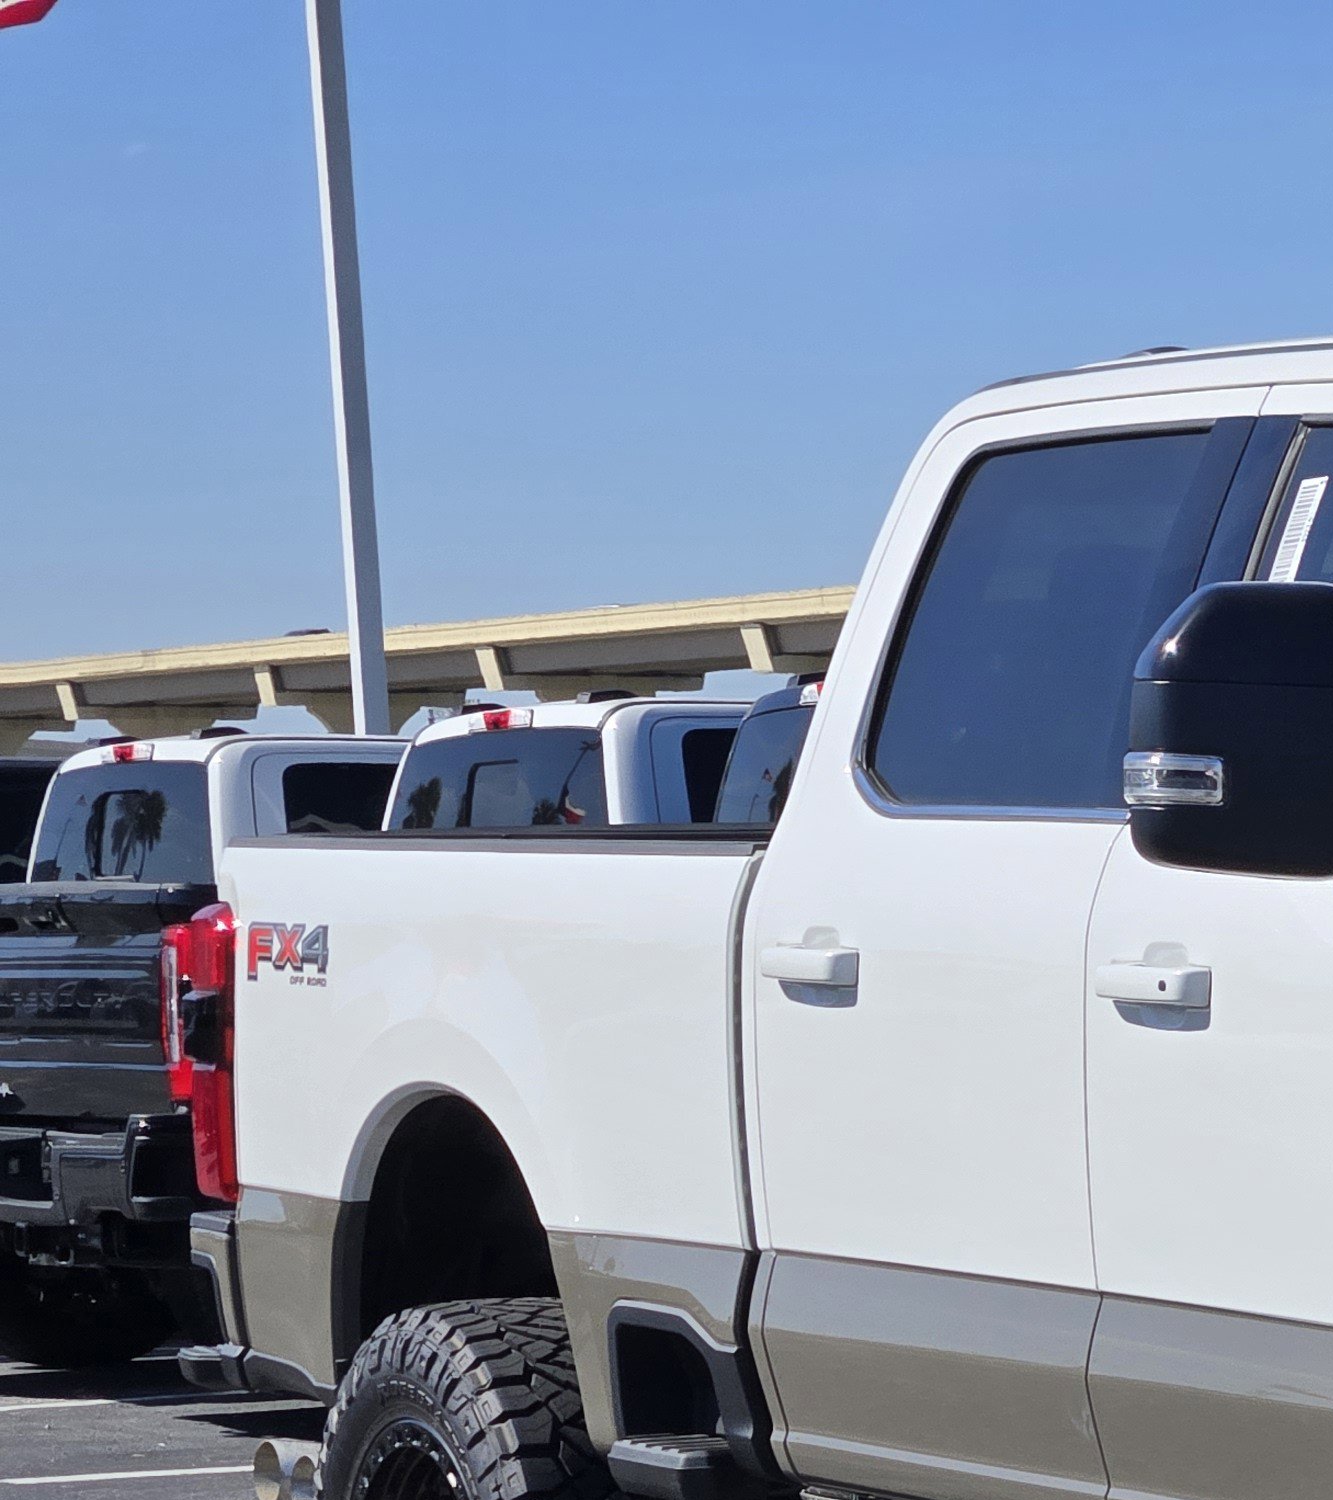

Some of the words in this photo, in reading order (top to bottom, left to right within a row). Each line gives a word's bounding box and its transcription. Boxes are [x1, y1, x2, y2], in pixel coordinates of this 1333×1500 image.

[248, 921, 329, 981] FX4
[289, 976, 304, 985] OFF
[306, 977, 327, 987] ROAD
